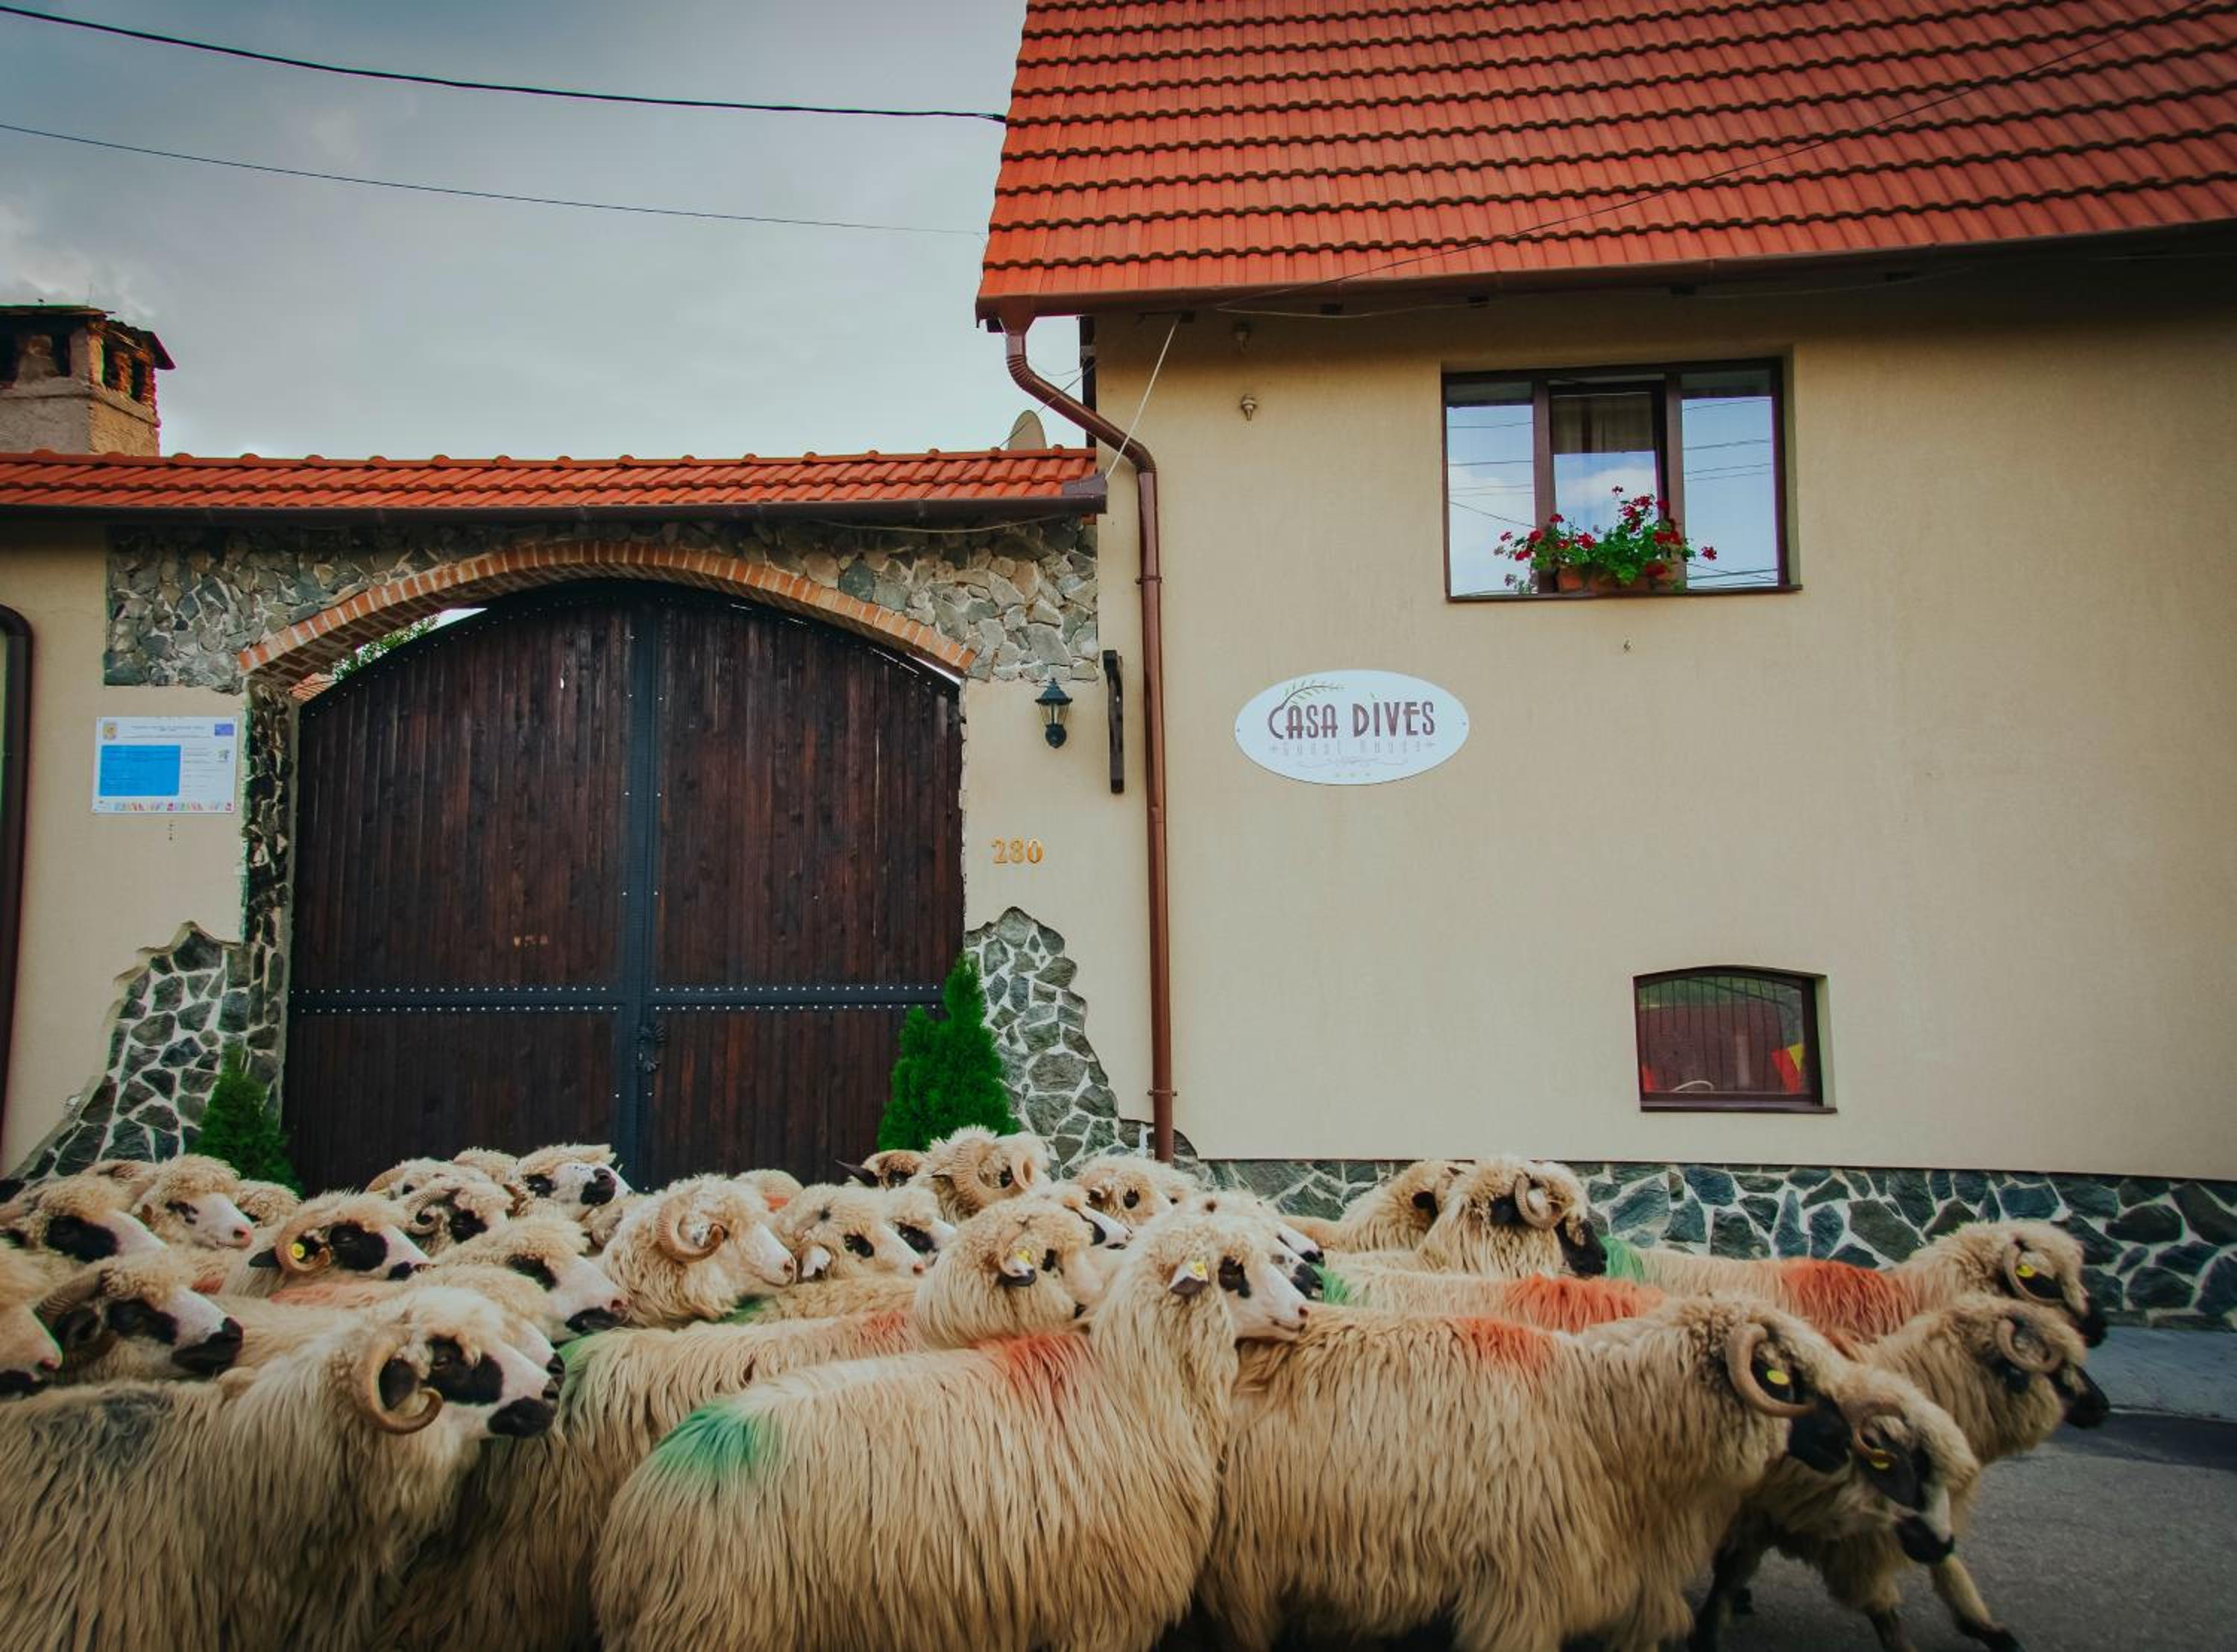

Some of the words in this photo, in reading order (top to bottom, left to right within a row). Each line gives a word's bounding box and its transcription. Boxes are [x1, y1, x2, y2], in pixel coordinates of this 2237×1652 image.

[1268, 704, 1338, 740] CASA
[1353, 702, 1435, 738] DIVES
[991, 839, 1043, 864] 280
